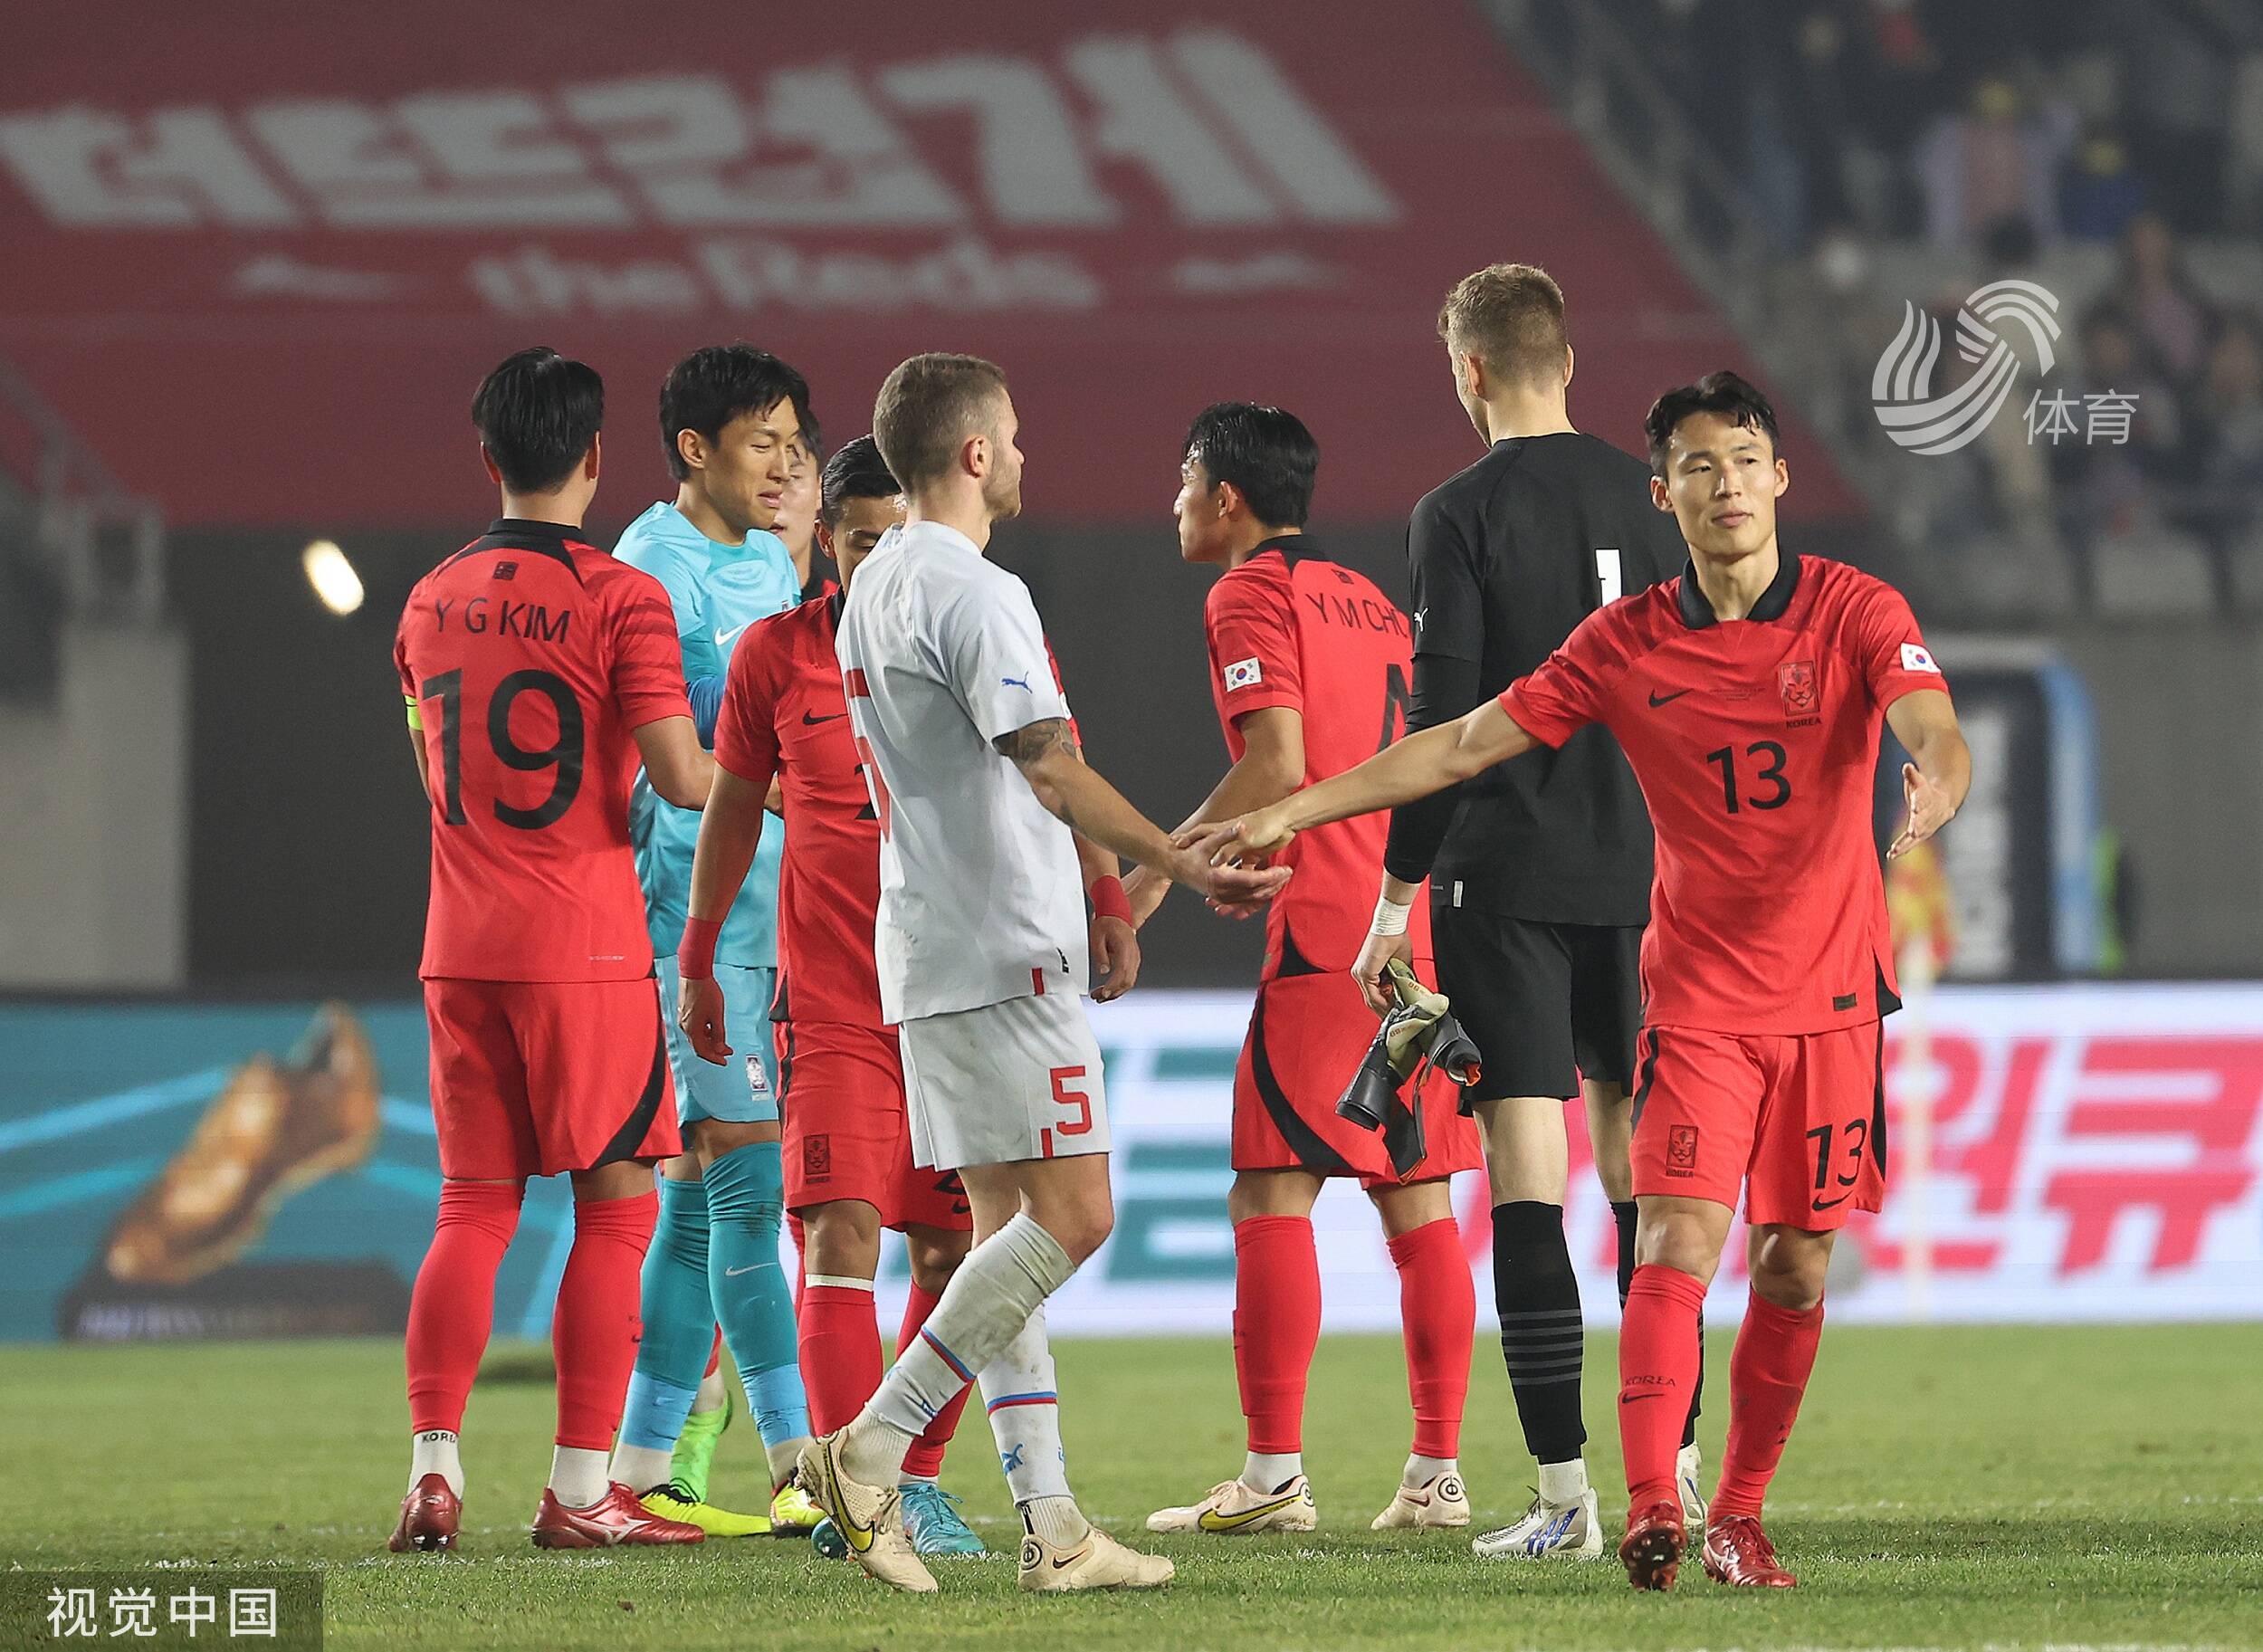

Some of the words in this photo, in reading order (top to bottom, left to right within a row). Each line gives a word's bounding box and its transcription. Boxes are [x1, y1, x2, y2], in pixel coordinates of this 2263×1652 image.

[471, 246, 701, 314] the
[699, 235, 1102, 313] Reds
[435, 597, 454, 633] Y
[465, 597, 488, 634] G
[499, 600, 571, 644] KIM
[1305, 593, 1329, 624] Y
[1332, 595, 1361, 629] M
[423, 667, 585, 830] 19
[1785, 716, 1822, 730] KOREA
[1706, 740, 1791, 814] 13
[1048, 1065, 1093, 1136] 5
[1806, 1118, 1867, 1189] 13
[1624, 1375, 1676, 1388] KOREA
[422, 1432, 456, 1443] KORE
